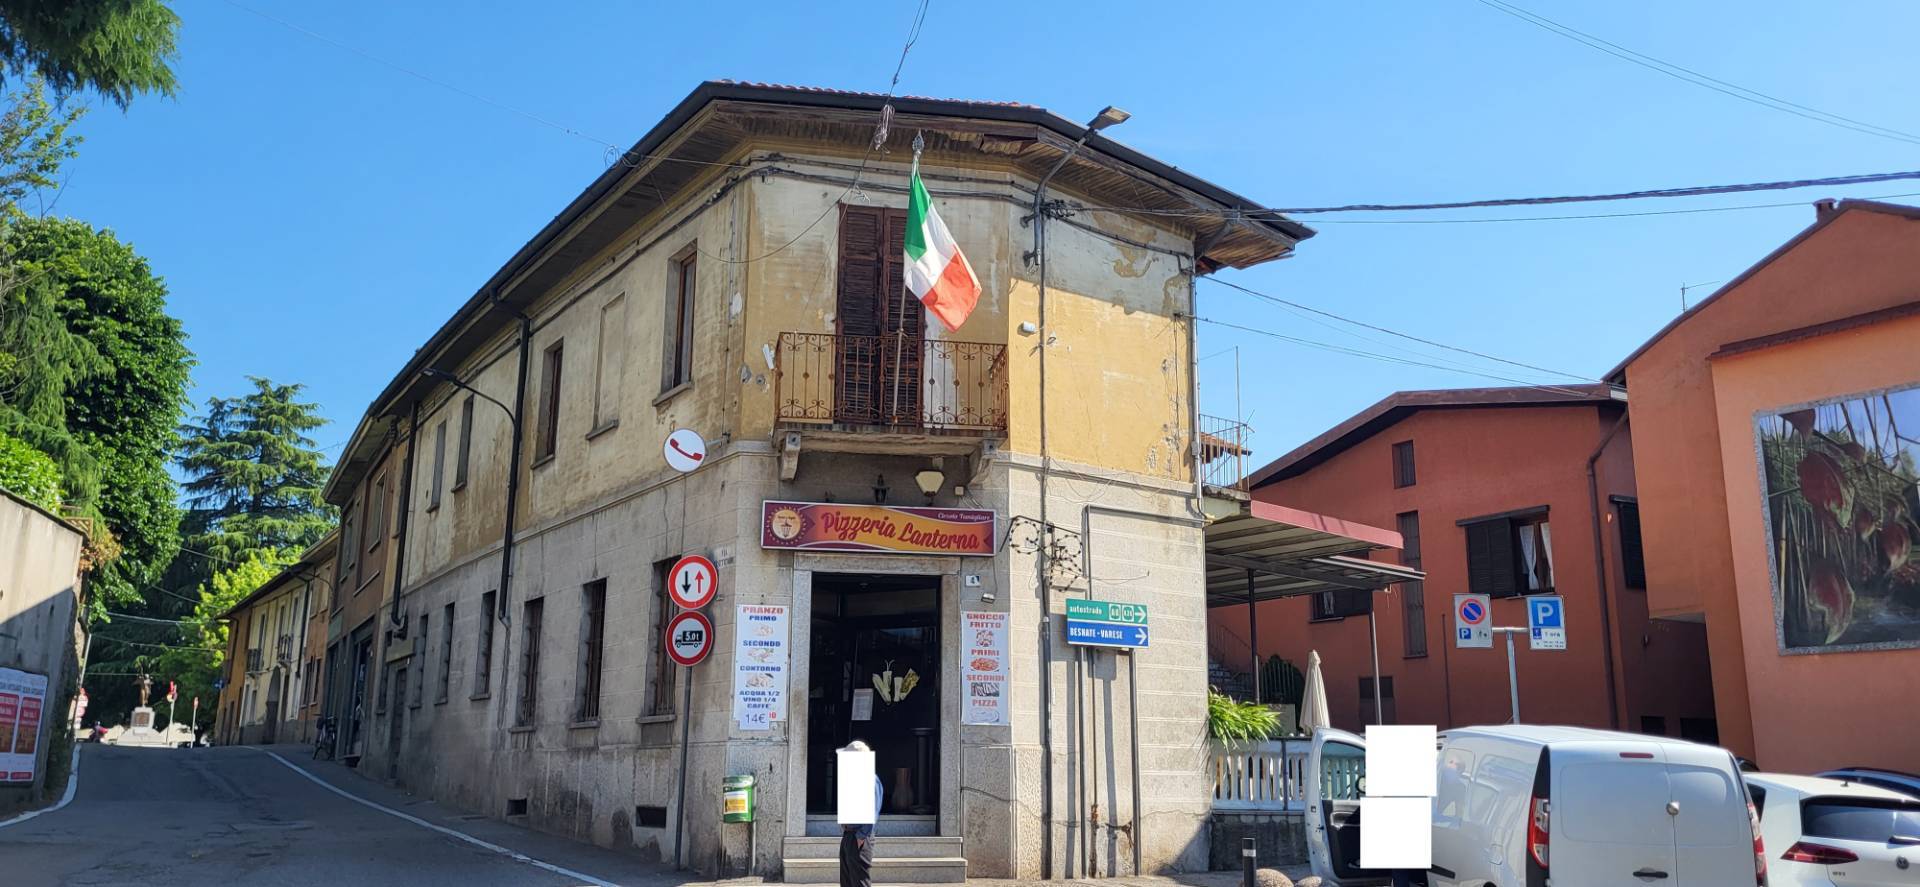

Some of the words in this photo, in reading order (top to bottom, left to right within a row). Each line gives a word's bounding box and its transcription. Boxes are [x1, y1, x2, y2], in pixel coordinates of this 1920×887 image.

[821, 511, 896, 542] Pizzeria
[897, 521, 979, 550] Lanterna
[743, 606, 784, 614] PRANZO
[1537, 602, 1554, 624] P
[1070, 628, 1097, 637] BESNATE
[1101, 629, 1123, 639] VARESE
[972, 699, 998, 707] PIZZA
[745, 713, 766, 724] 14€
